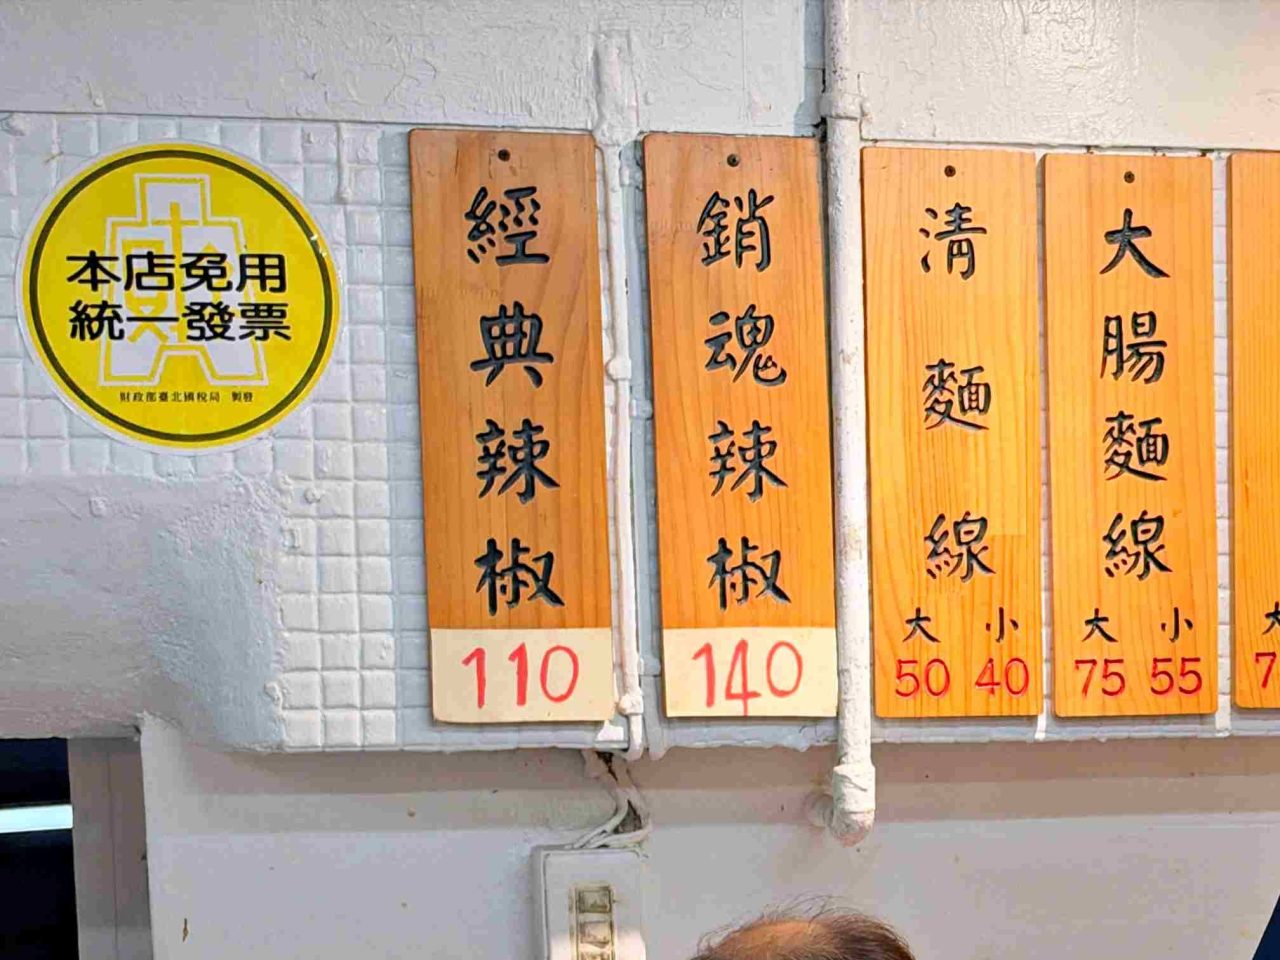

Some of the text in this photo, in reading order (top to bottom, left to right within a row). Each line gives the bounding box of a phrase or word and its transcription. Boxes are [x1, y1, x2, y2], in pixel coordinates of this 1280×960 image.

[66, 250, 287, 293] 本店免用
[68, 299, 292, 342] 統一發票
[464, 185, 565, 617] 經典辣椒
[696, 188, 792, 611] 銷魂辣椒
[918, 202, 996, 583] 清麵線
[1100, 208, 1172, 581] 大腸麵線
[902, 606, 1019, 644] 大 小
[1082, 606, 1194, 643] 大 小
[461, 643, 580, 708] 110
[692, 639, 803, 718] 140
[894, 656, 1031, 698] 50 40
[1073, 656, 1203, 698] 75 55
